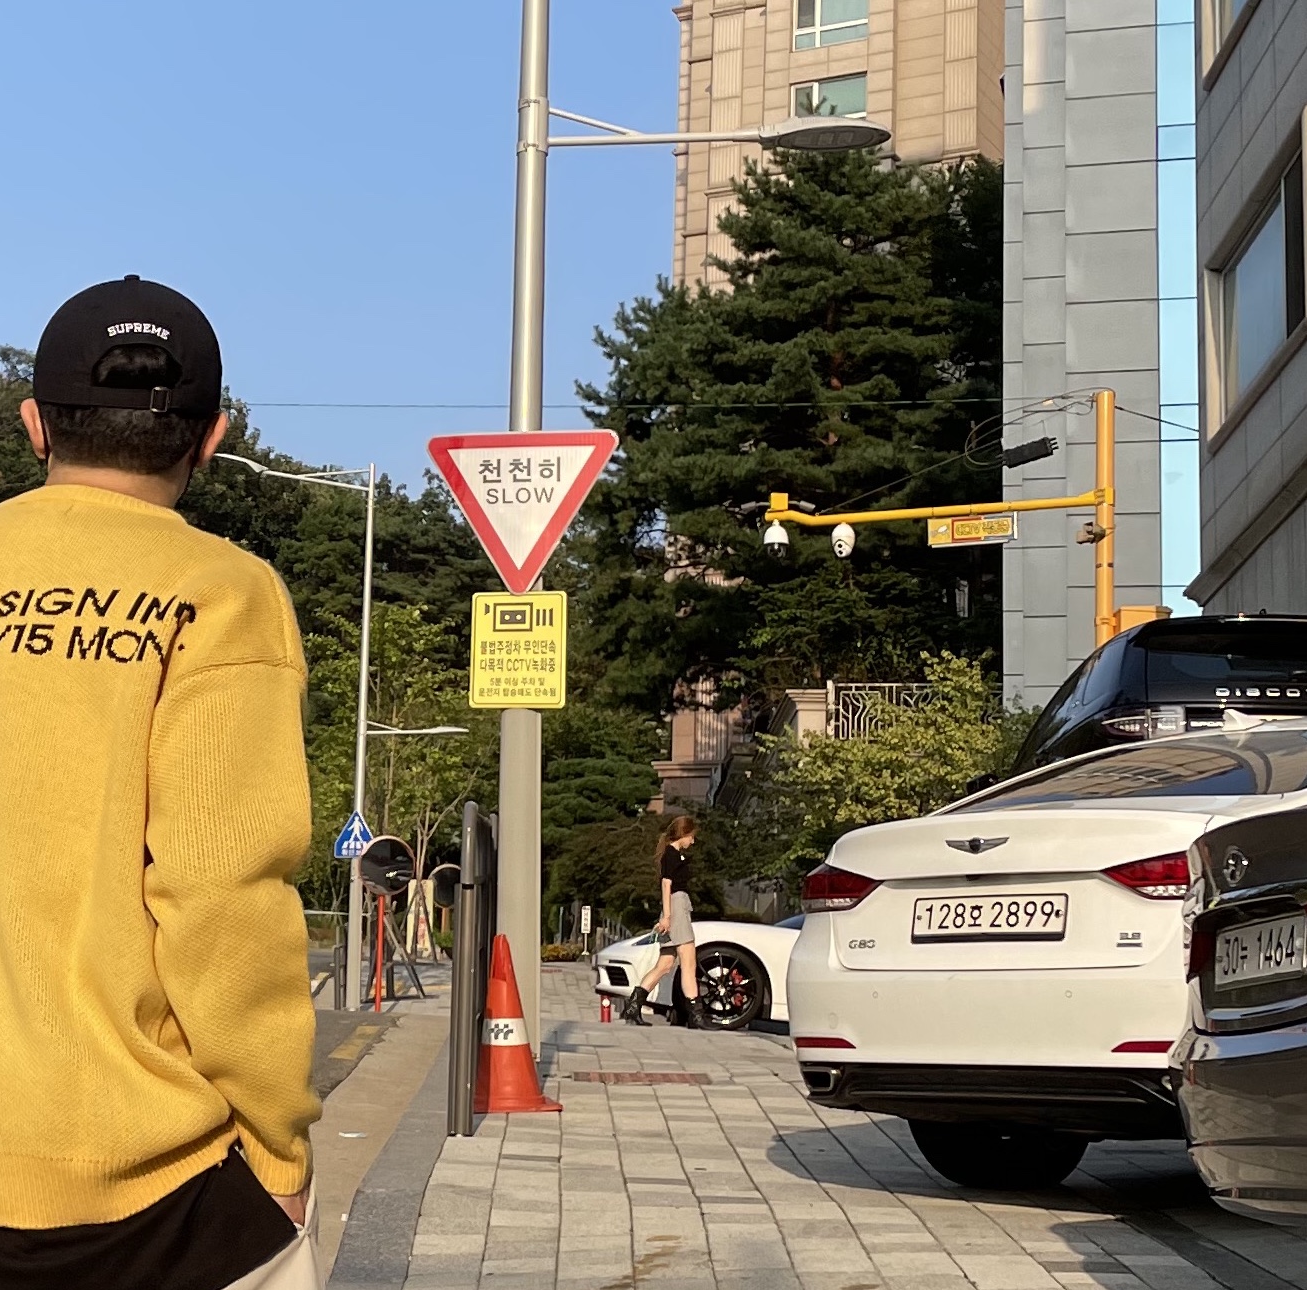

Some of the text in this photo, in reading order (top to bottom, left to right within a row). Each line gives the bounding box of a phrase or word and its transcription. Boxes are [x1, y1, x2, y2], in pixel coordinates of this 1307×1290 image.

[107, 322, 171, 341] SUPREME
[478, 456, 561, 484] 천천히
[486, 487, 554, 505] SLOW
[480, 640, 556, 655] 불법주정차 무인단속
[480, 658, 503, 672] 다목적
[1215, 687, 1307, 697] DISCO
[925, 900, 1055, 930] 128호 2899
[1257, 925, 1295, 970] 1464
